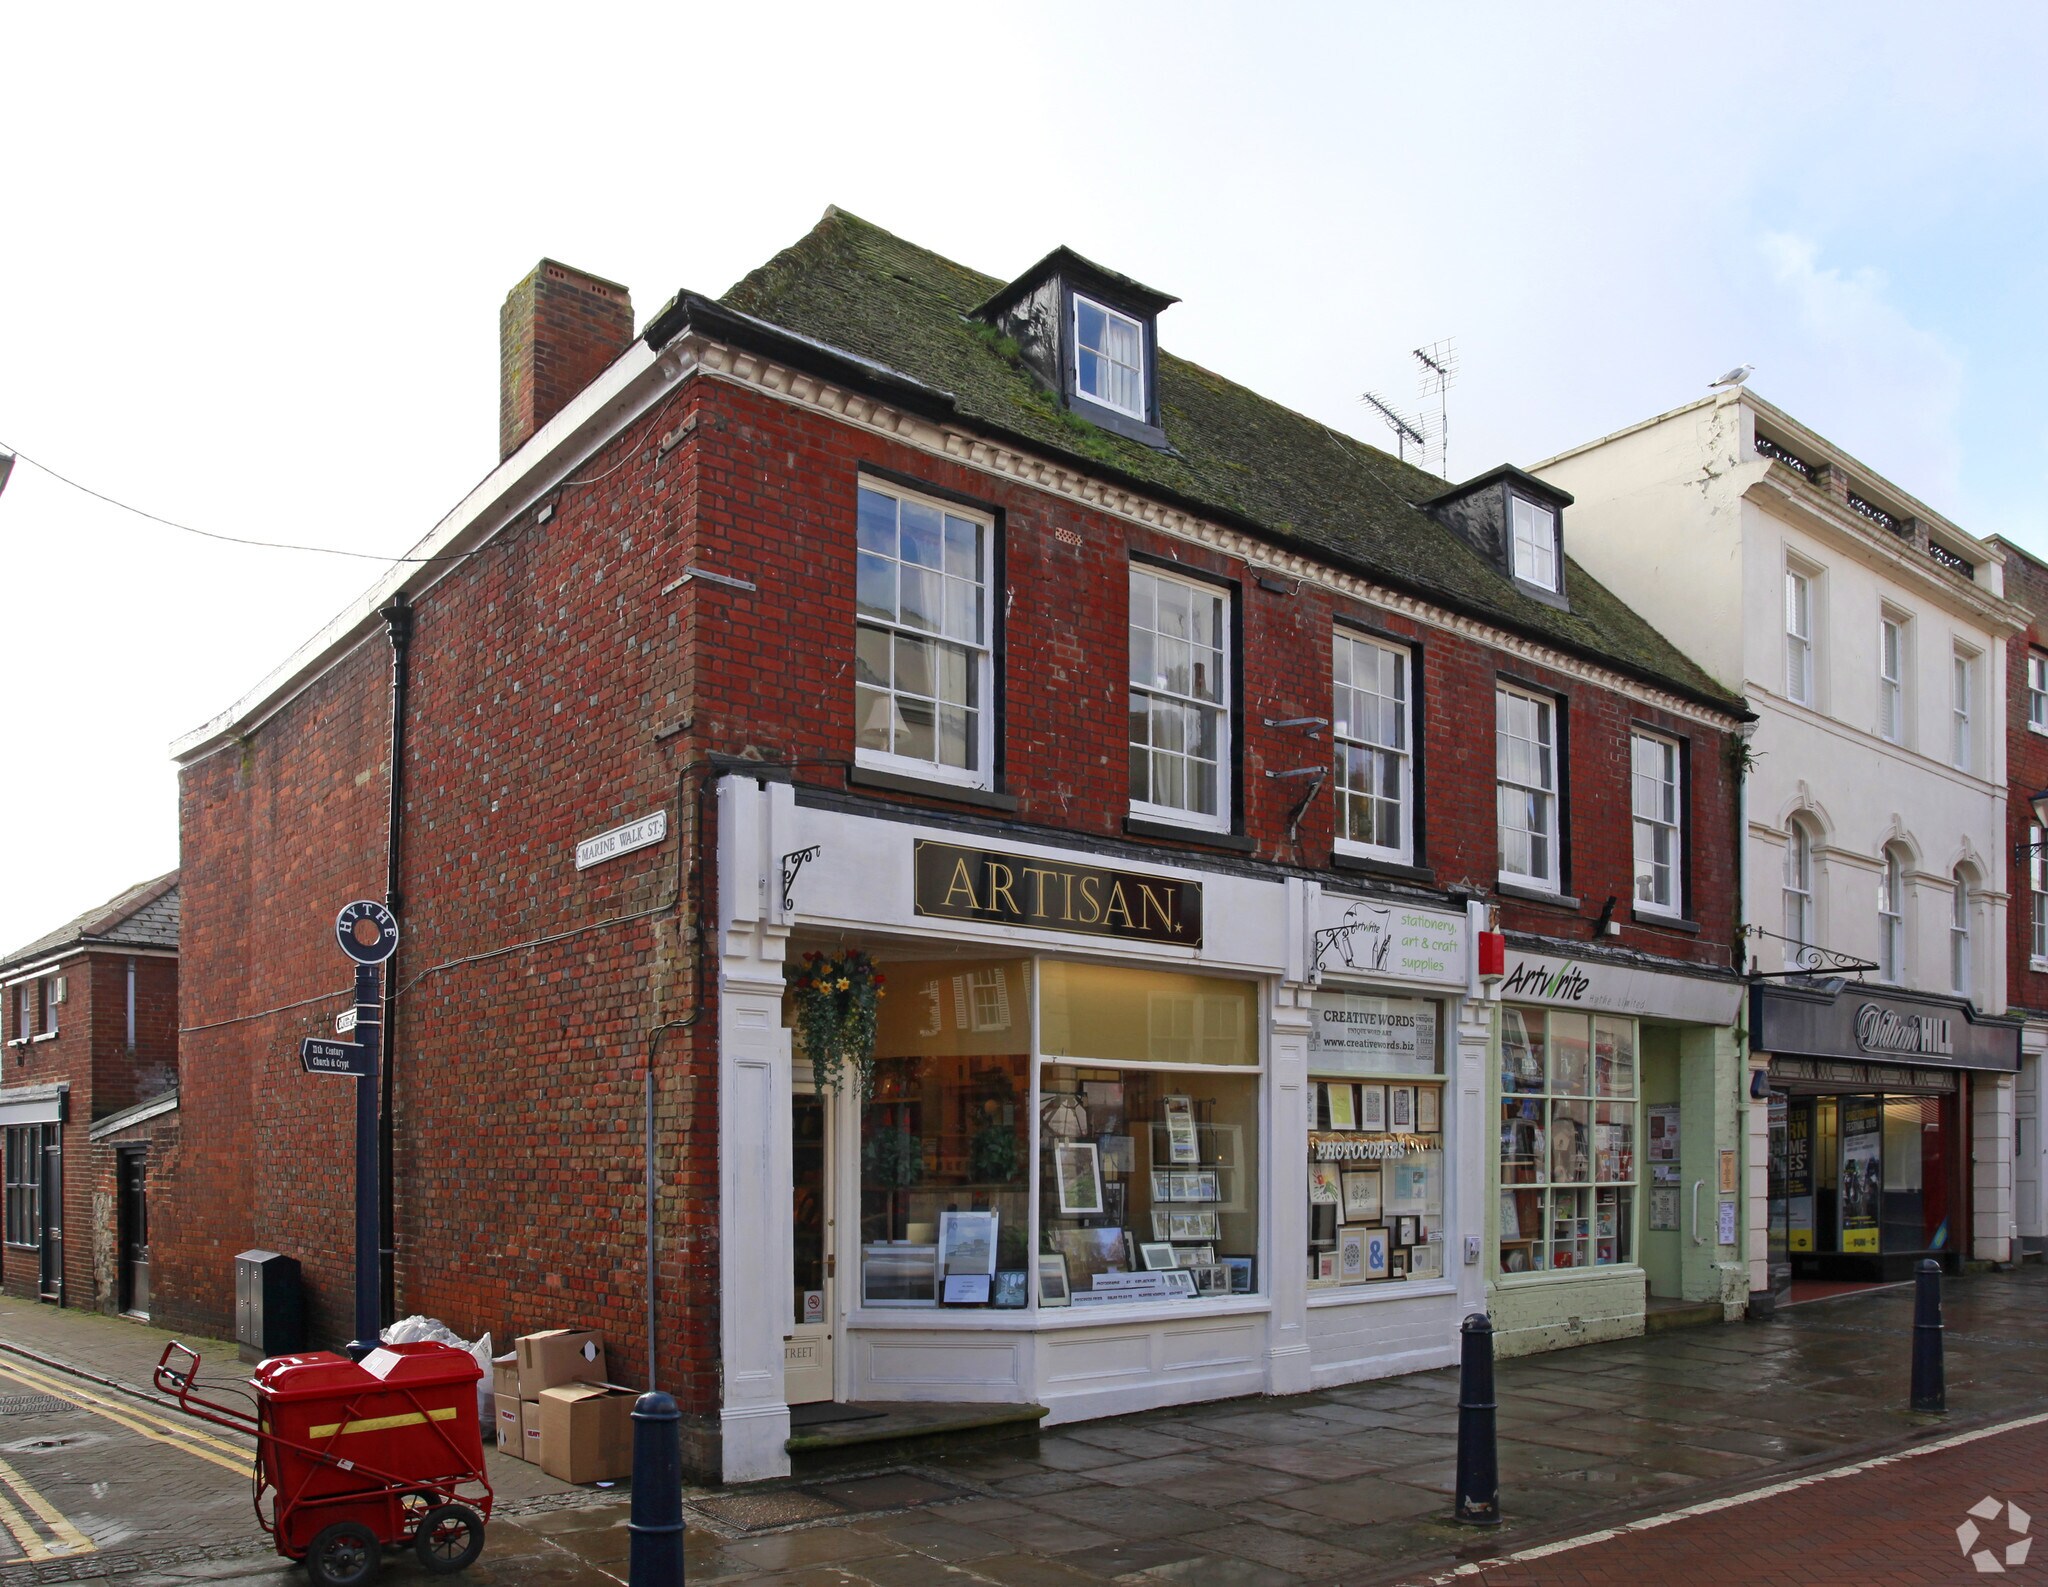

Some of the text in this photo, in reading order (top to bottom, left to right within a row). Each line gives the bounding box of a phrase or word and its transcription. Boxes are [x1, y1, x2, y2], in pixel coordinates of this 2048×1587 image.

[581, 820, 660, 861] MARINE WALK ST.
[940, 857, 1176, 933] ARTISAN
[339, 903, 396, 938] HYTHE
[1401, 914, 1457, 935] stationery,
[1401, 935, 1458, 952] art & craft
[1401, 957, 1444, 973] supplies
[1501, 960, 1589, 1001] Artwrite
[1589, 994, 1611, 1006] Hythe
[1323, 1009, 1376, 1025] CREATIVE
[1378, 1013, 1415, 1028] WORDS
[1347, 1027, 1367, 1036] UNIQUE
[1857, 1003, 1953, 1054] William HILL
[325, 1046, 344, 1058] Century
[1323, 1039, 1415, 1051] www.creativewords.biz
[312, 1056, 350, 1070] Church & Crypt
[1316, 1141, 1405, 1160] PHOTOCOPIES
[784, 1346, 814, 1359] TREET
